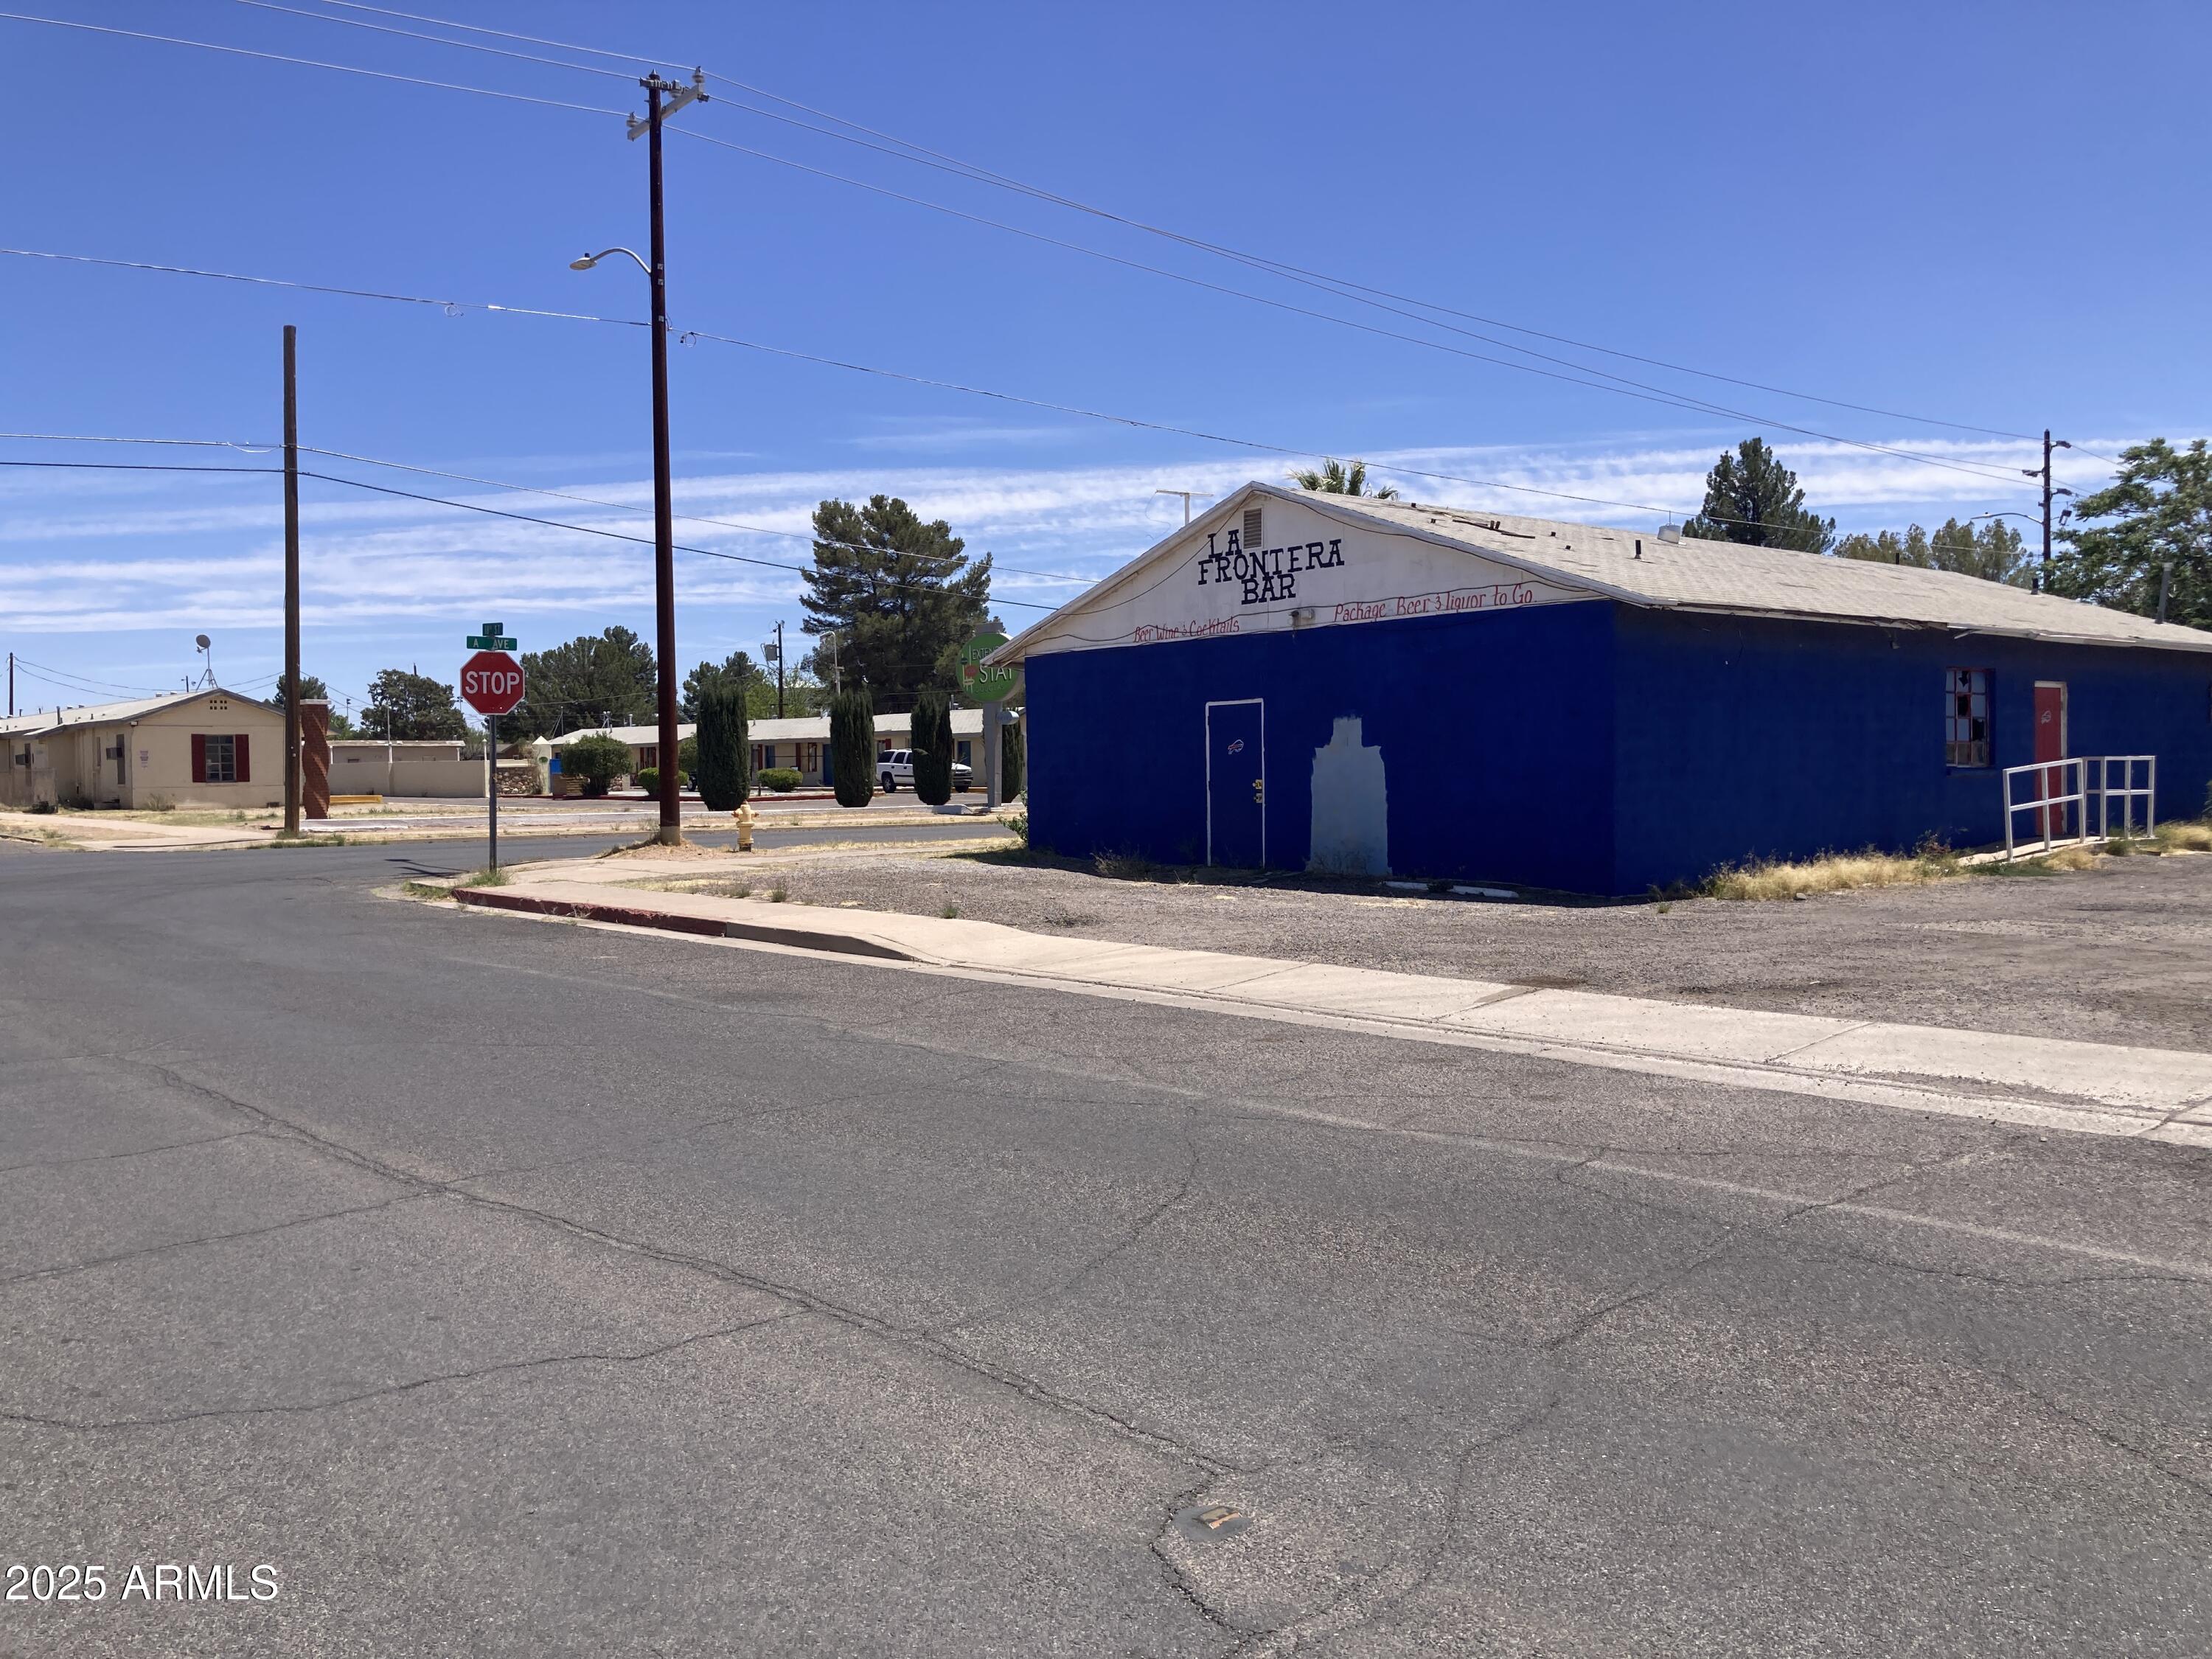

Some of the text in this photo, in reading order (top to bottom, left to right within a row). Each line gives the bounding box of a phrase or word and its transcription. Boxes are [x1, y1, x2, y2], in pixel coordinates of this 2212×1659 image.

[1208, 529, 1242, 559] LA
[1198, 539, 1345, 585] FRONTERA
[1241, 573, 1296, 605] BAR
[1397, 597, 1430, 616] Beer
[1492, 585, 1508, 605] to
[473, 638, 509, 650] A AVE
[1133, 626, 1154, 643] Beer
[1155, 624, 1179, 640] Wine
[973, 647, 1000, 661] EXTEN
[465, 671, 520, 695] STOP
